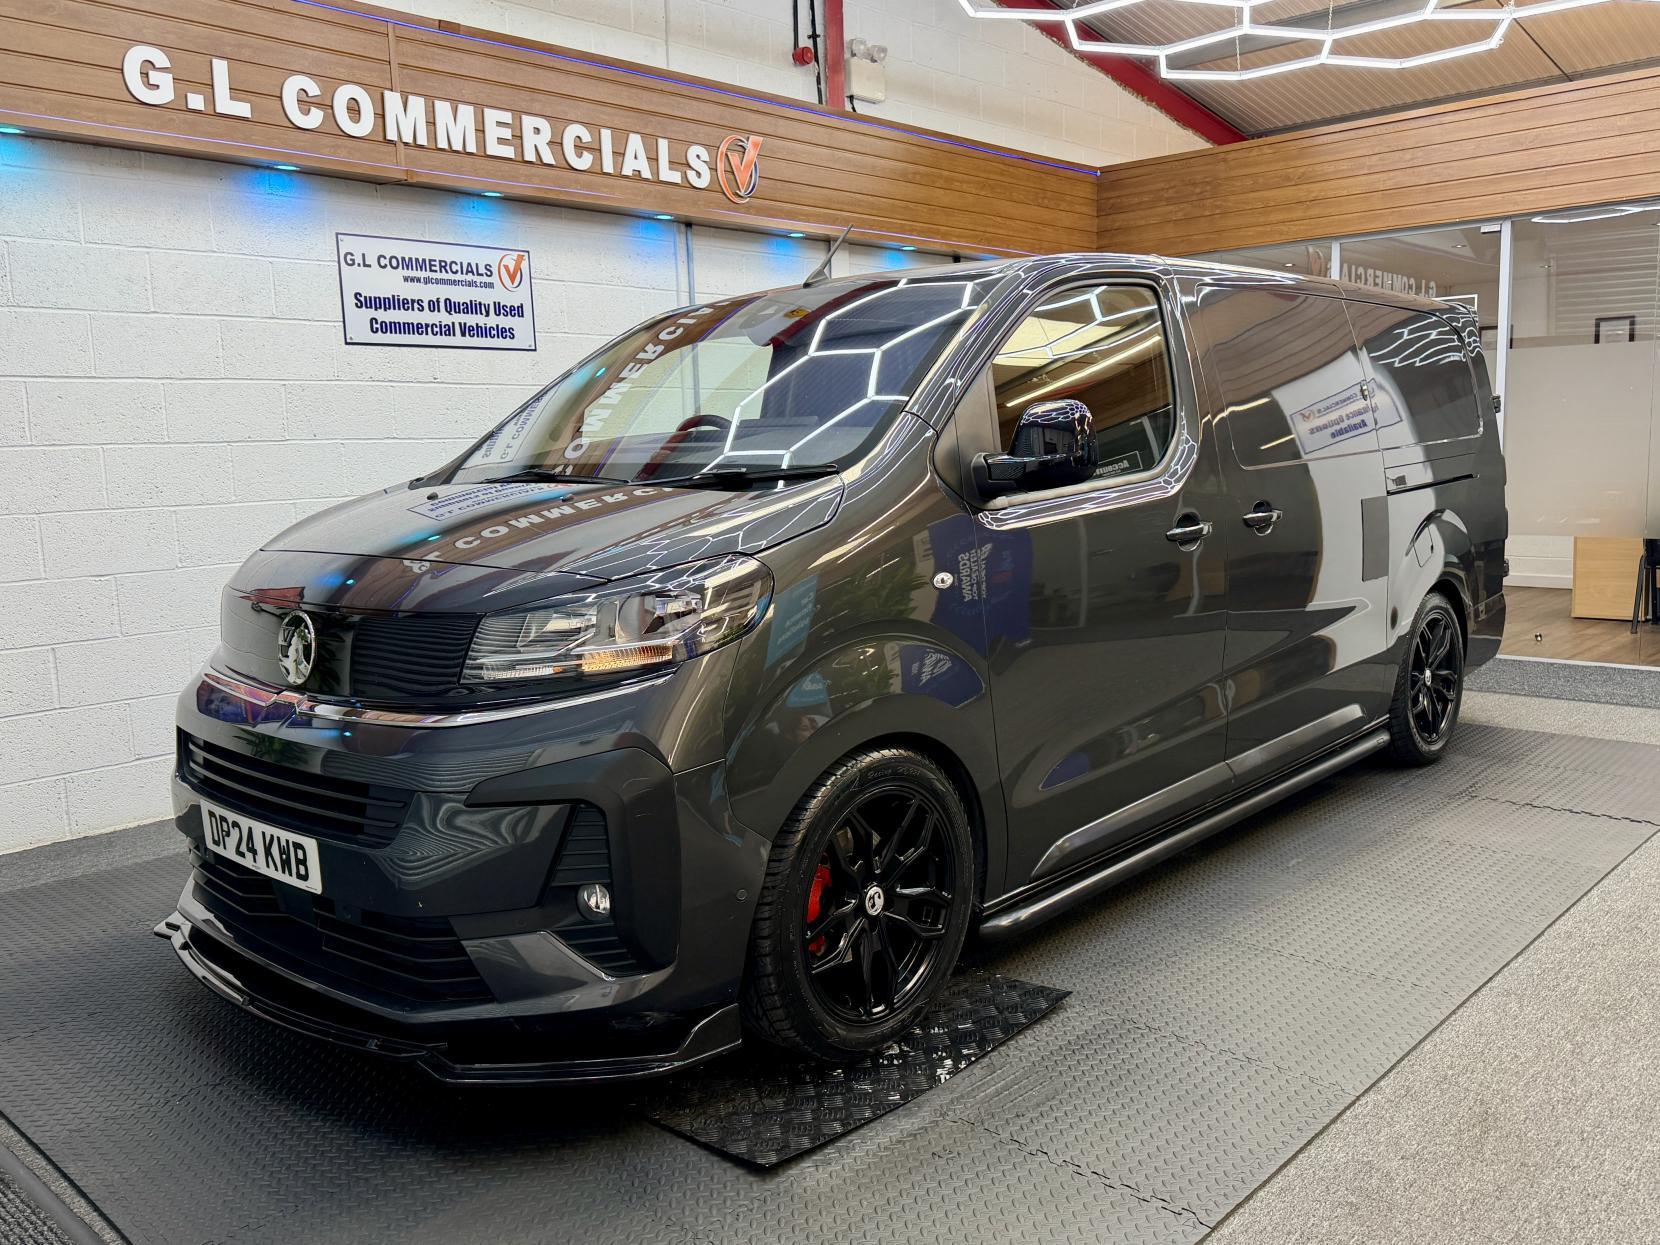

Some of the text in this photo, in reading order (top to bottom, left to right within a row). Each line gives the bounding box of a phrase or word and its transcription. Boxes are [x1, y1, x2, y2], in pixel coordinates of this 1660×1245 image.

[122, 45, 711, 189] G.L COMMERCIALS
[343, 251, 494, 278] G.L COMMERCIALS
[402, 273, 495, 290] www.glcommercials.com
[354, 292, 525, 318] Suppliers of Quality Used
[369, 317, 516, 340] Commercial Vehicles
[207, 809, 310, 882] DP24 KWB
